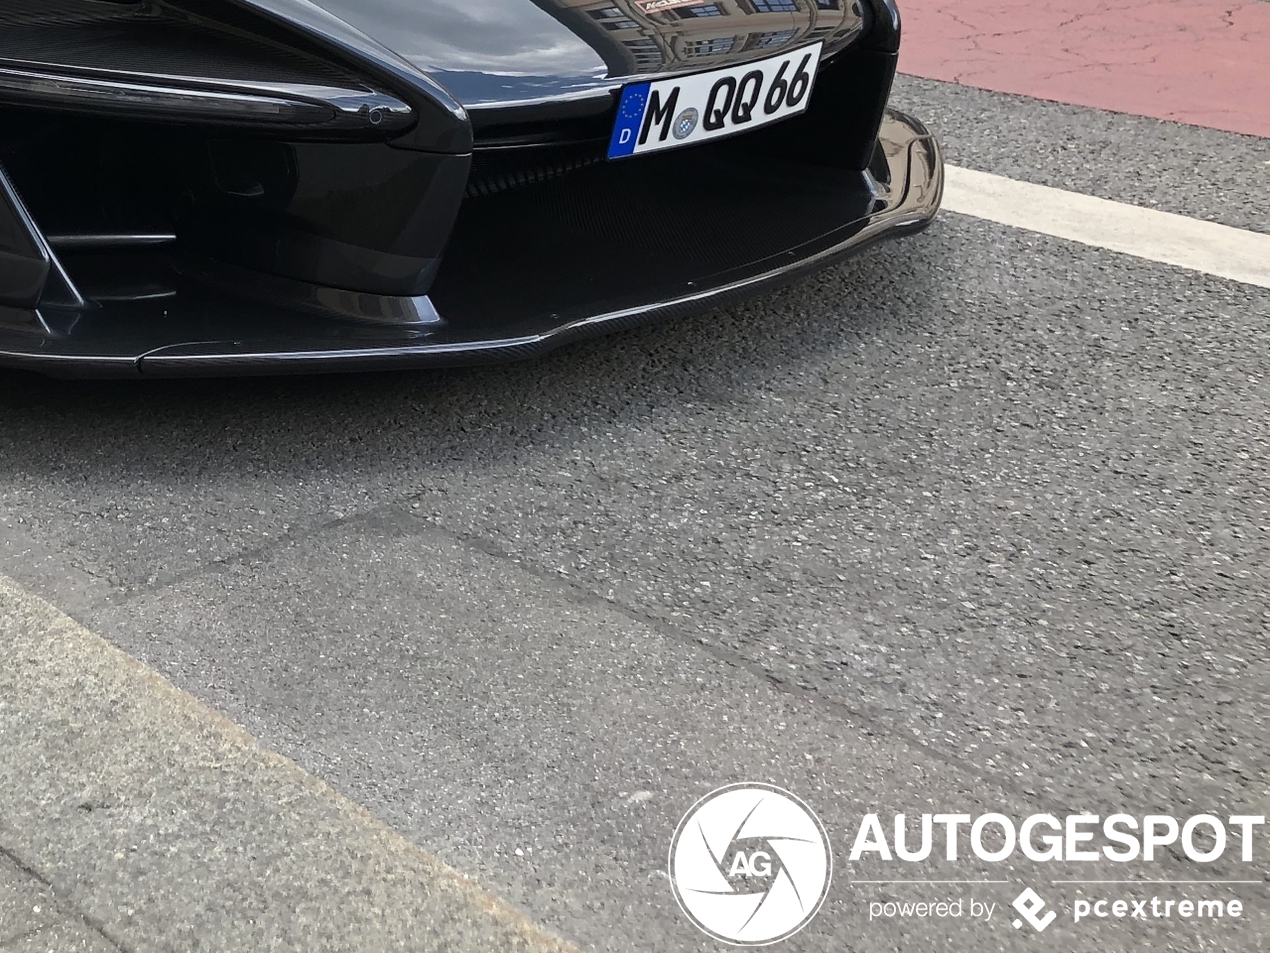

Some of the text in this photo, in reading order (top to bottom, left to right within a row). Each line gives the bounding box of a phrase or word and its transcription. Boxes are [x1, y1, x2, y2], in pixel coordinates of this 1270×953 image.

[637, 53, 812, 146] M QQ 66
[618, 128, 631, 144] D
